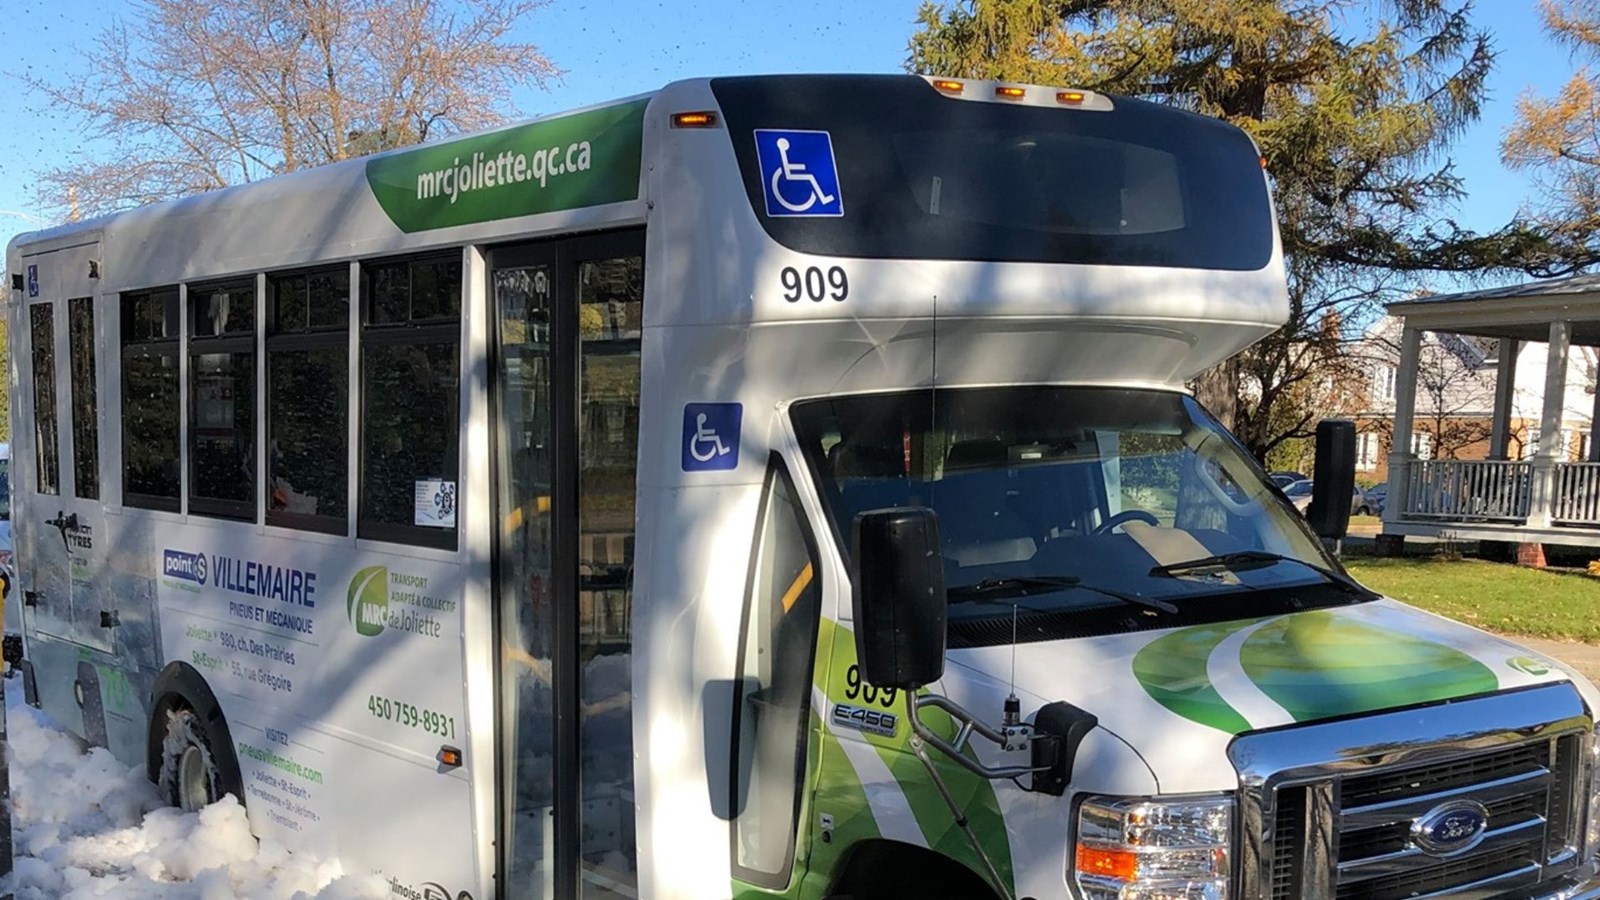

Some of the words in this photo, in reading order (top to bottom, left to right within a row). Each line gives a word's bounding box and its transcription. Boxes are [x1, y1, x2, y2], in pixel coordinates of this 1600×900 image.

[417, 140, 592, 204] mrcjoliette.qc.ca
[780, 265, 849, 303] 909
[68, 533, 92, 549] TYRES
[166, 554, 192, 574] point
[212, 555, 316, 608] VILLEMAIRE
[391, 572, 428, 588] TRANSPORT
[362, 602, 387, 627] MRC
[391, 591, 416, 605] ADAPTÉ
[422, 596, 456, 613] COLLECTIF
[229, 601, 254, 620] PNEUS
[255, 608, 265, 622] ET
[266, 606, 313, 634] MÉCANIQUE
[250, 639, 264, 656] Des
[265, 643, 296, 666] Prairies
[244, 668, 257, 681] rue
[258, 667, 292, 692] Grégoire
[368, 694, 392, 720] 450
[394, 700, 455, 739] 759-8931
[1441, 816, 1475, 839] Ford
[385, 875, 422, 900] linoise
